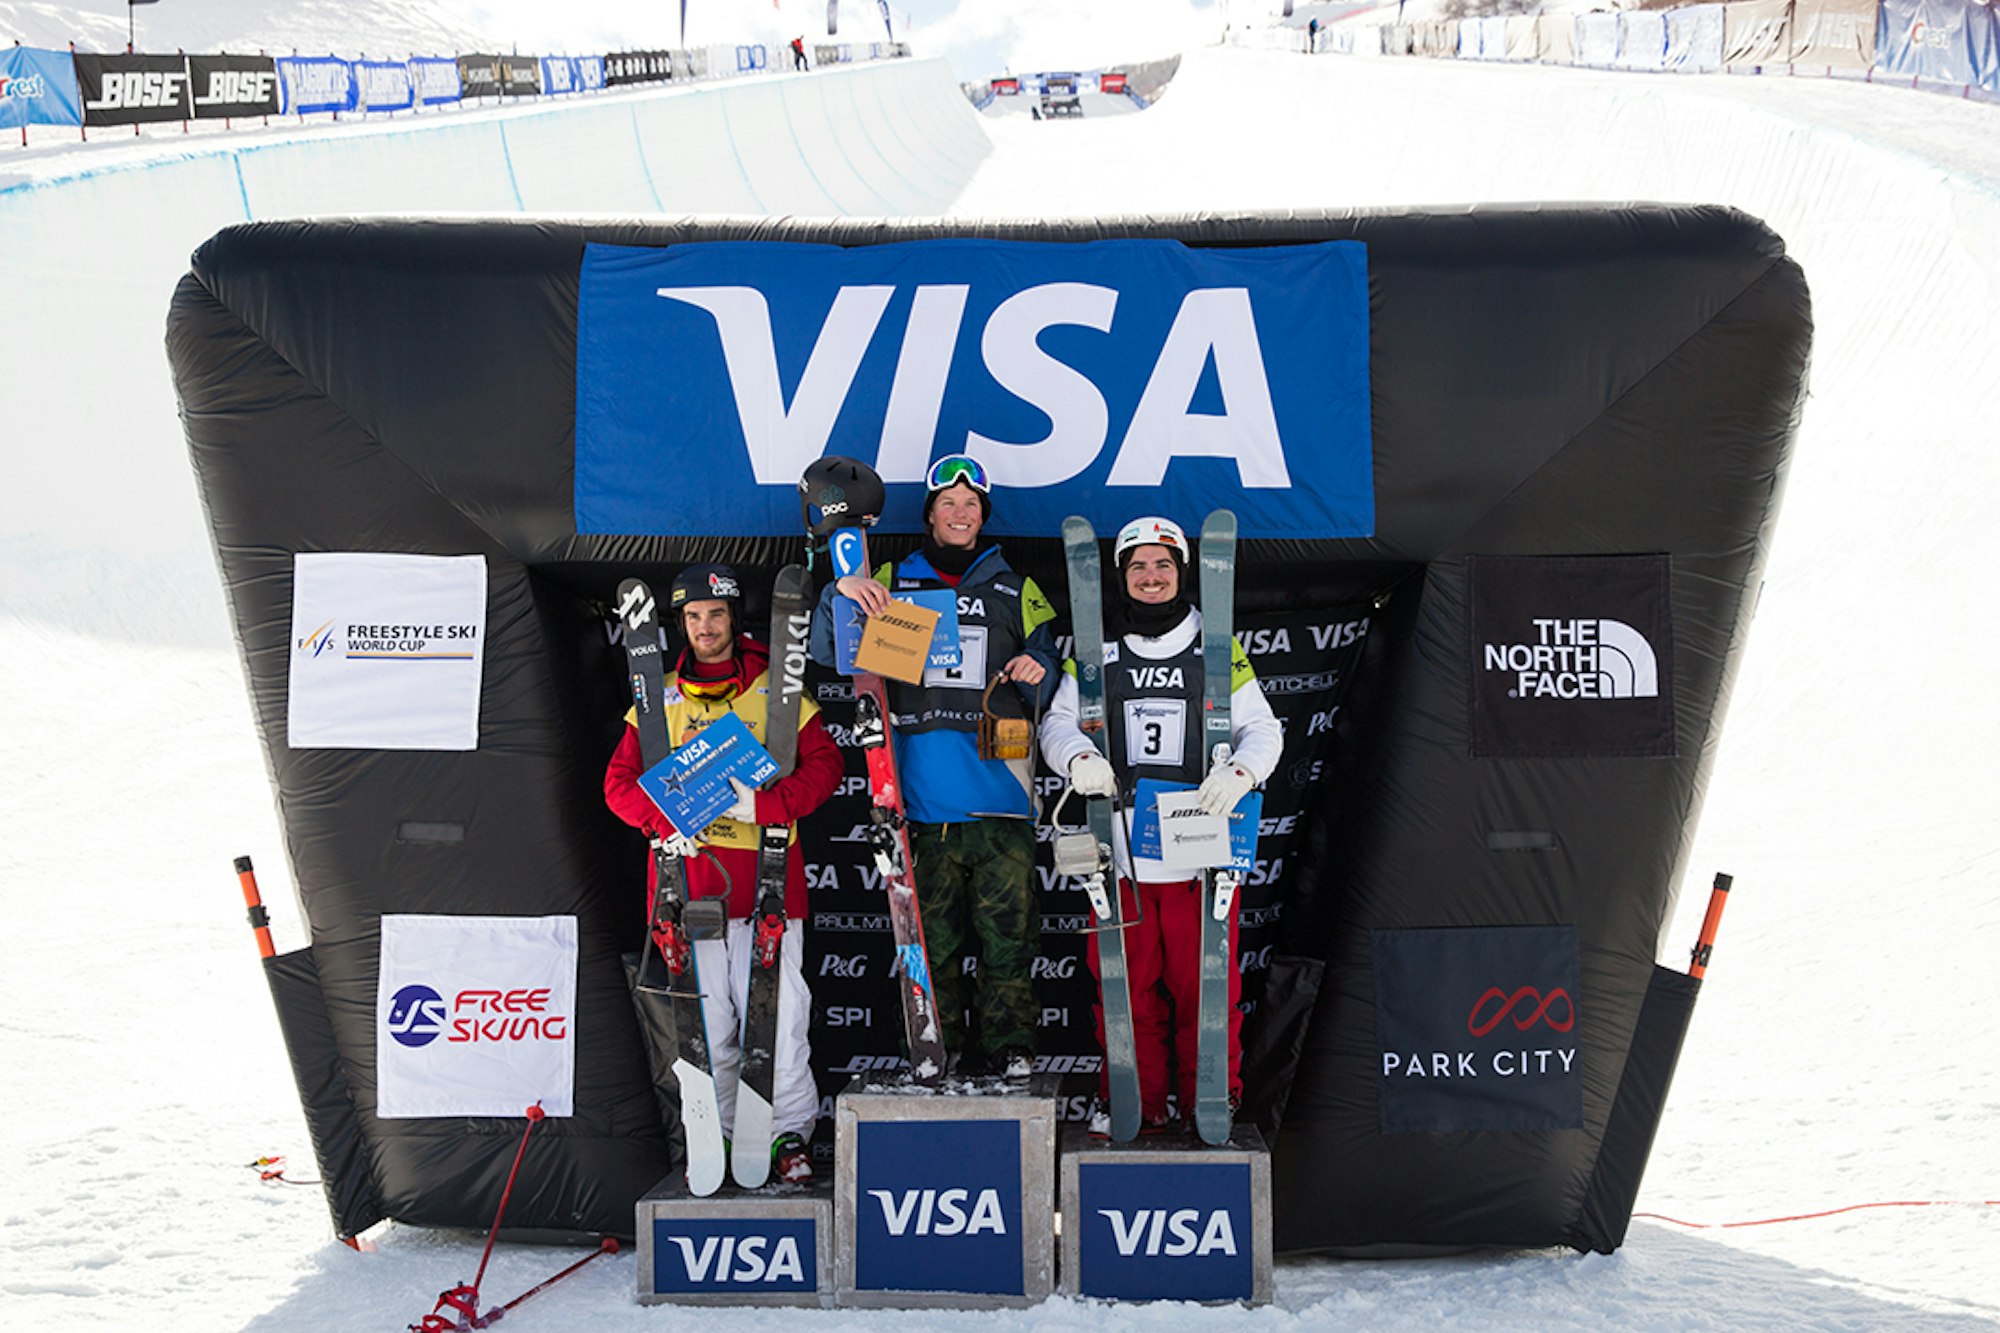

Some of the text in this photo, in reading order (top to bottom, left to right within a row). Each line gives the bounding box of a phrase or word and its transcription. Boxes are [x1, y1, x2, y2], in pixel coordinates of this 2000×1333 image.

[86, 72, 187, 110] BOSE
[195, 71, 275, 105] BOSE
[657, 281, 1293, 488] VISA
[957, 596, 986, 617] SA
[347, 625, 477, 639] FREESTYLE SKI
[347, 639, 426, 651] WORLD CUP
[1305, 617, 1371, 651] VISA
[1532, 618, 1598, 646] THE
[930, 654, 958, 666] VISA
[1484, 643, 1598, 672] NORTH
[817, 684, 857, 698] PAU
[1127, 667, 1185, 689] VISA
[1518, 672, 1599, 699] FACE
[964, 711, 985, 721] CIT
[1144, 722, 1162, 755] 3
[675, 739, 711, 766] VISA
[750, 762, 777, 783] VISA
[1163, 807, 1210, 820] BOS
[804, 864, 840, 890] SA
[1035, 865, 1087, 892] VIS
[819, 954, 868, 978] P&G
[1031, 955, 1077, 979] P&G
[454, 988, 552, 1014] FREE
[447, 1016, 567, 1043] SKIING
[826, 1006, 872, 1027] SPI
[1037, 1007, 1069, 1028] PI
[1031, 1055, 1103, 1073] BOS
[1382, 1048, 1576, 1077] PARK CITY
[867, 1188, 1007, 1237] VISA
[1097, 1208, 1238, 1256] VISA
[668, 1235, 805, 1283] VISA
